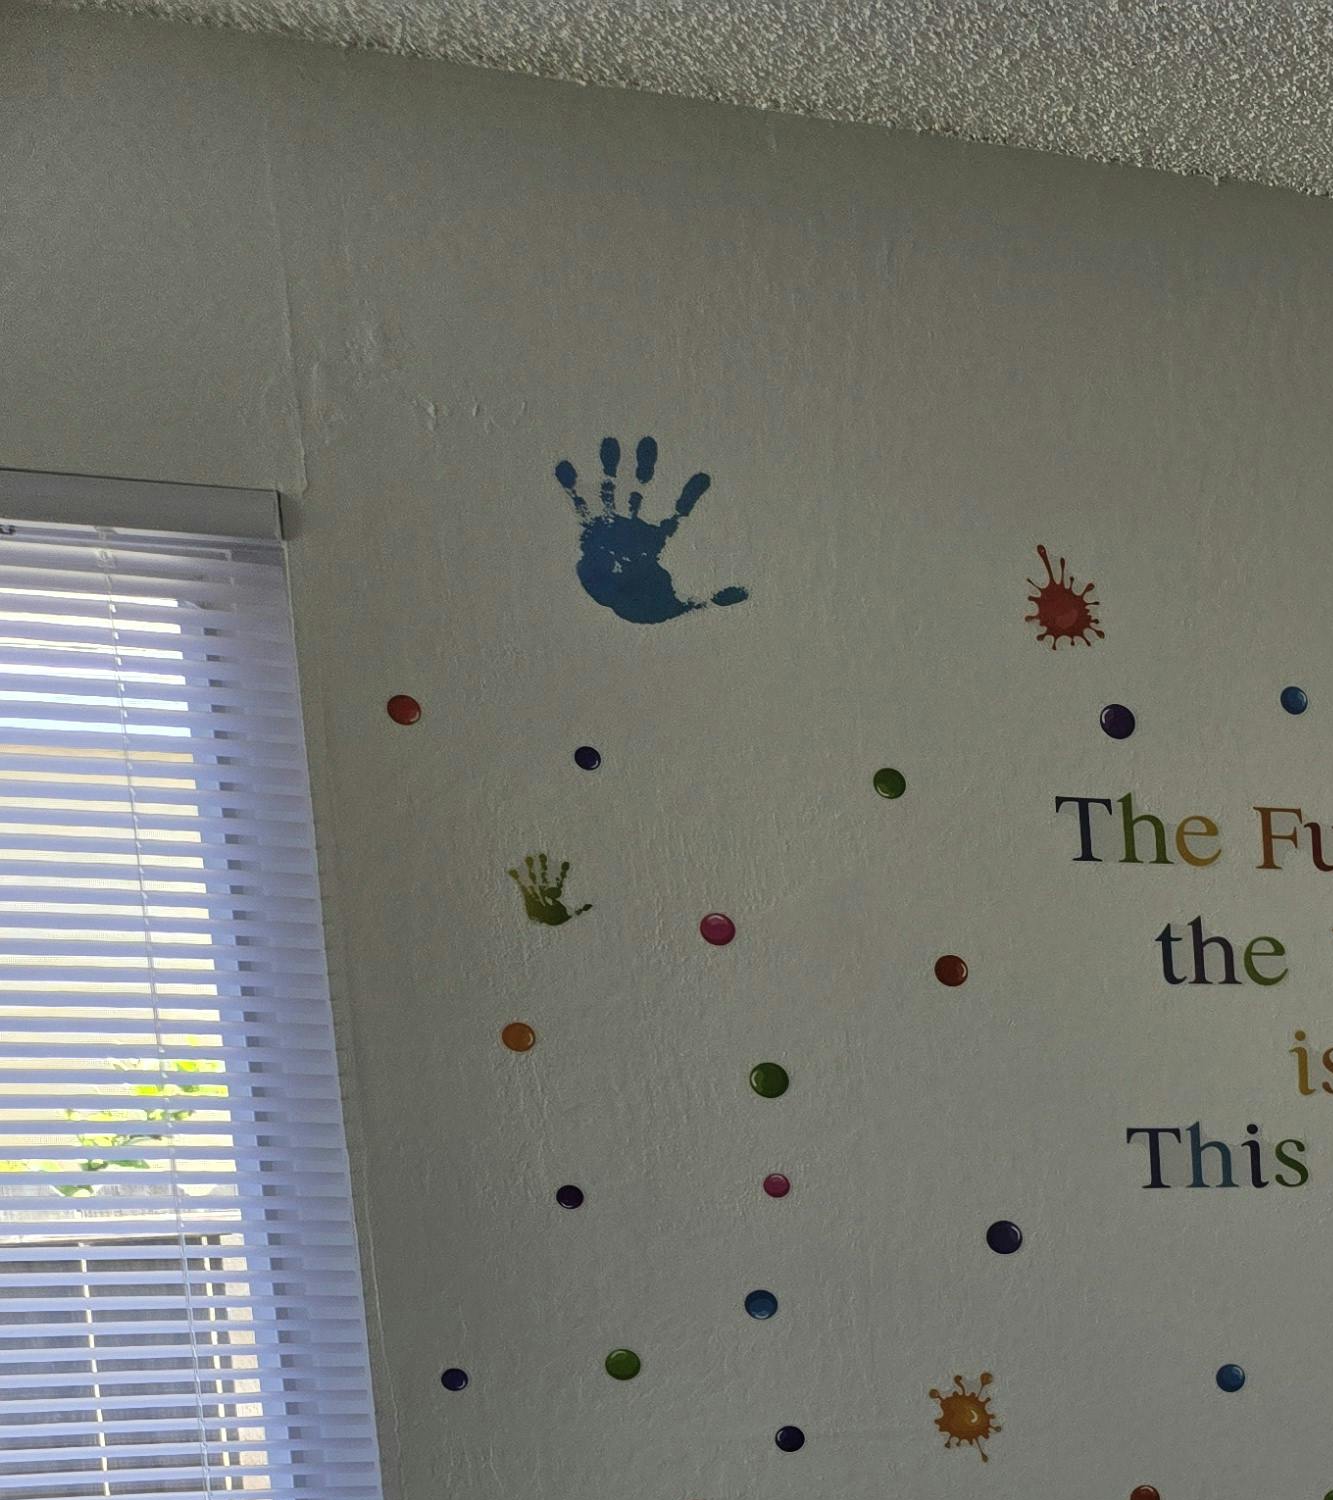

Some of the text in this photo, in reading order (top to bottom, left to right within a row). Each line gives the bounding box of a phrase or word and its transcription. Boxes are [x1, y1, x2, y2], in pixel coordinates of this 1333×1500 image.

[1055, 792, 1222, 867] The
[1155, 916, 1288, 986] the
[1126, 1122, 1310, 1190] This
